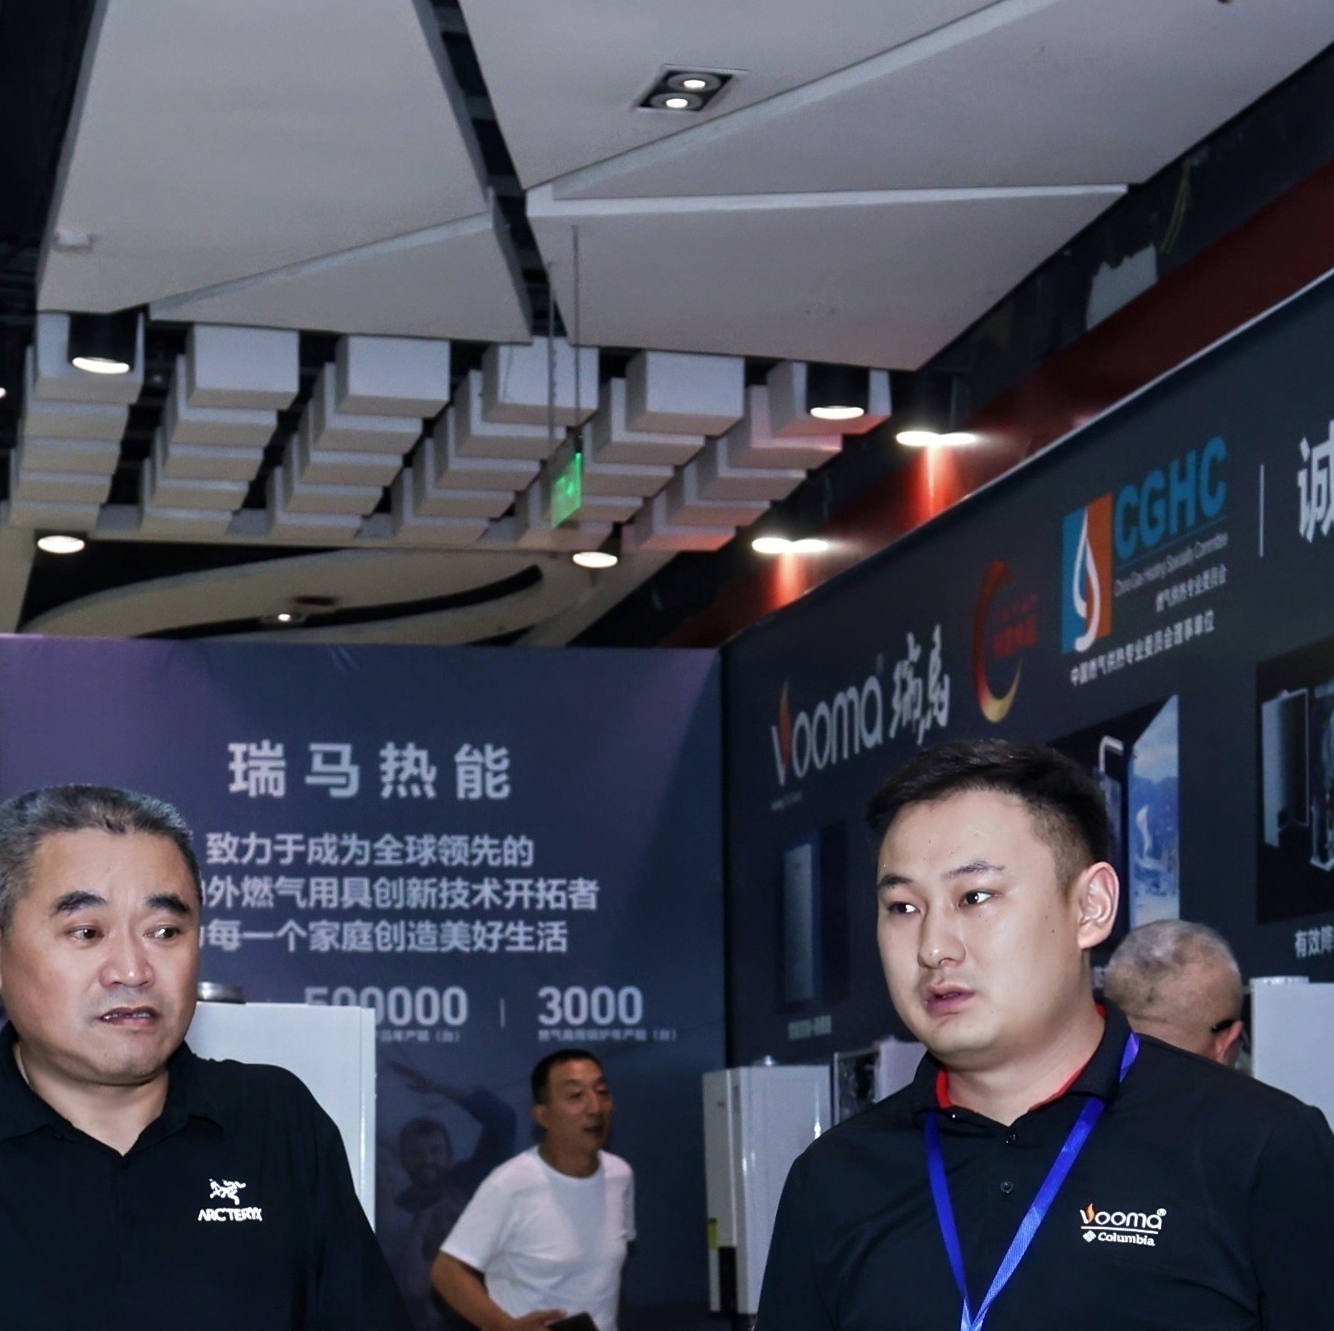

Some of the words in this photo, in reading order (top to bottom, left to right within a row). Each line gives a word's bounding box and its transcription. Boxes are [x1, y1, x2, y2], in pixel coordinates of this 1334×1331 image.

[1114, 436, 1227, 561] CGHC
[228, 740, 512, 800] 瑞马热能
[206, 832, 534, 867] 致力于成为全球领先的
[201, 877, 599, 910] 外燃气用具创新技术开拓者
[199, 920, 568, 953] 每一个家庭创造美好生活
[537, 986, 644, 1026] 3000
[1097, 1231, 1156, 1247] Columbia
